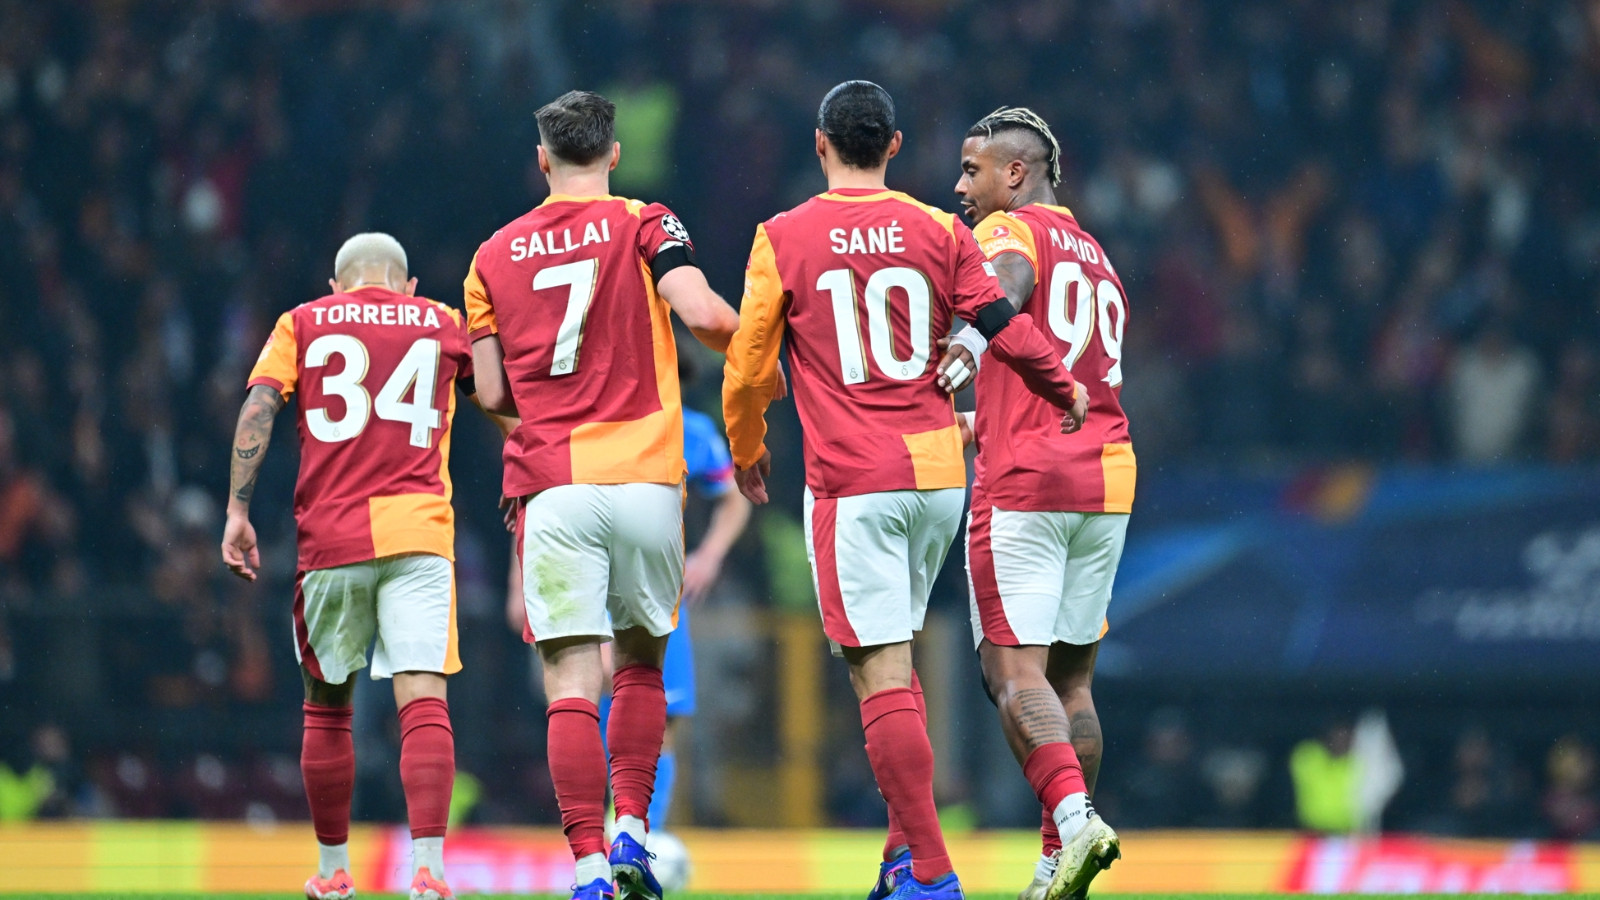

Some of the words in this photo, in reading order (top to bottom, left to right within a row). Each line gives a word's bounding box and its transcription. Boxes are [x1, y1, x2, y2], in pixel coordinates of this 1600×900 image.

[510, 218, 611, 262] SALLAI
[829, 220, 906, 254] SANÉ
[311, 303, 441, 329] TORREIRA
[532, 257, 600, 377] 7
[816, 266, 934, 386] 10
[1047, 261, 1126, 388] 99
[304, 333, 442, 449] 34
